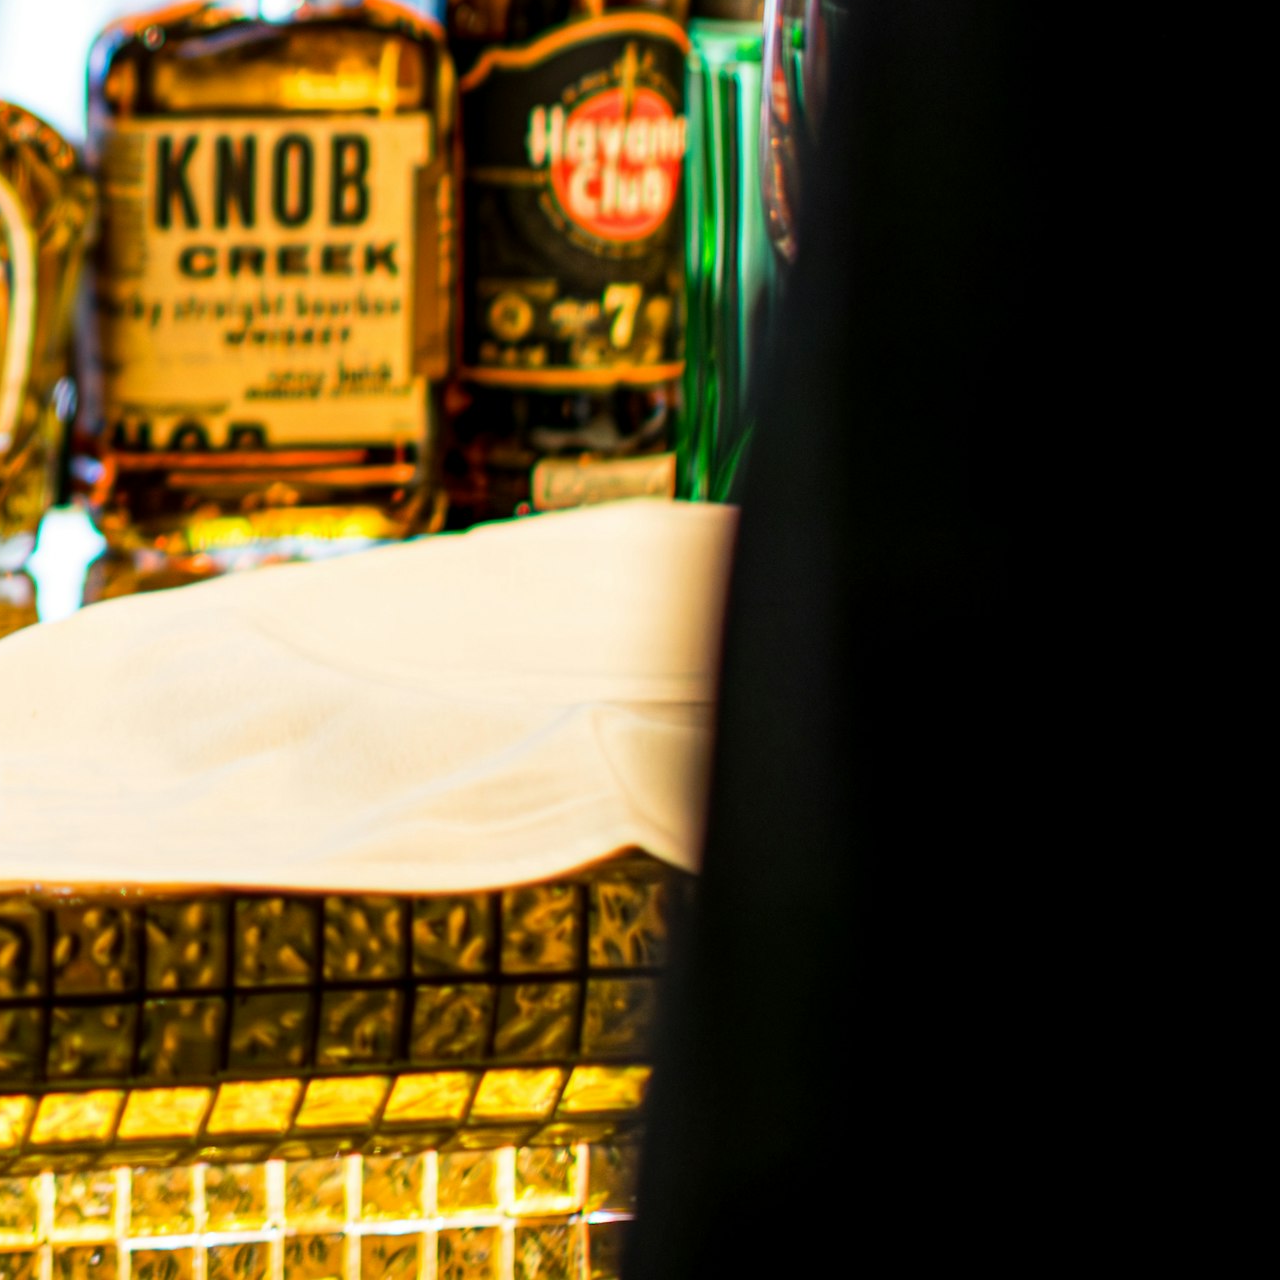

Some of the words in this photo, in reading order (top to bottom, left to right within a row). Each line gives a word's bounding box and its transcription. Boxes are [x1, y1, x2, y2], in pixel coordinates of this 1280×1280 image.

[156, 134, 371, 229] KNOB
[569, 161, 664, 219] Club
[179, 243, 399, 279] CREEK
[603, 283, 642, 348] 7
